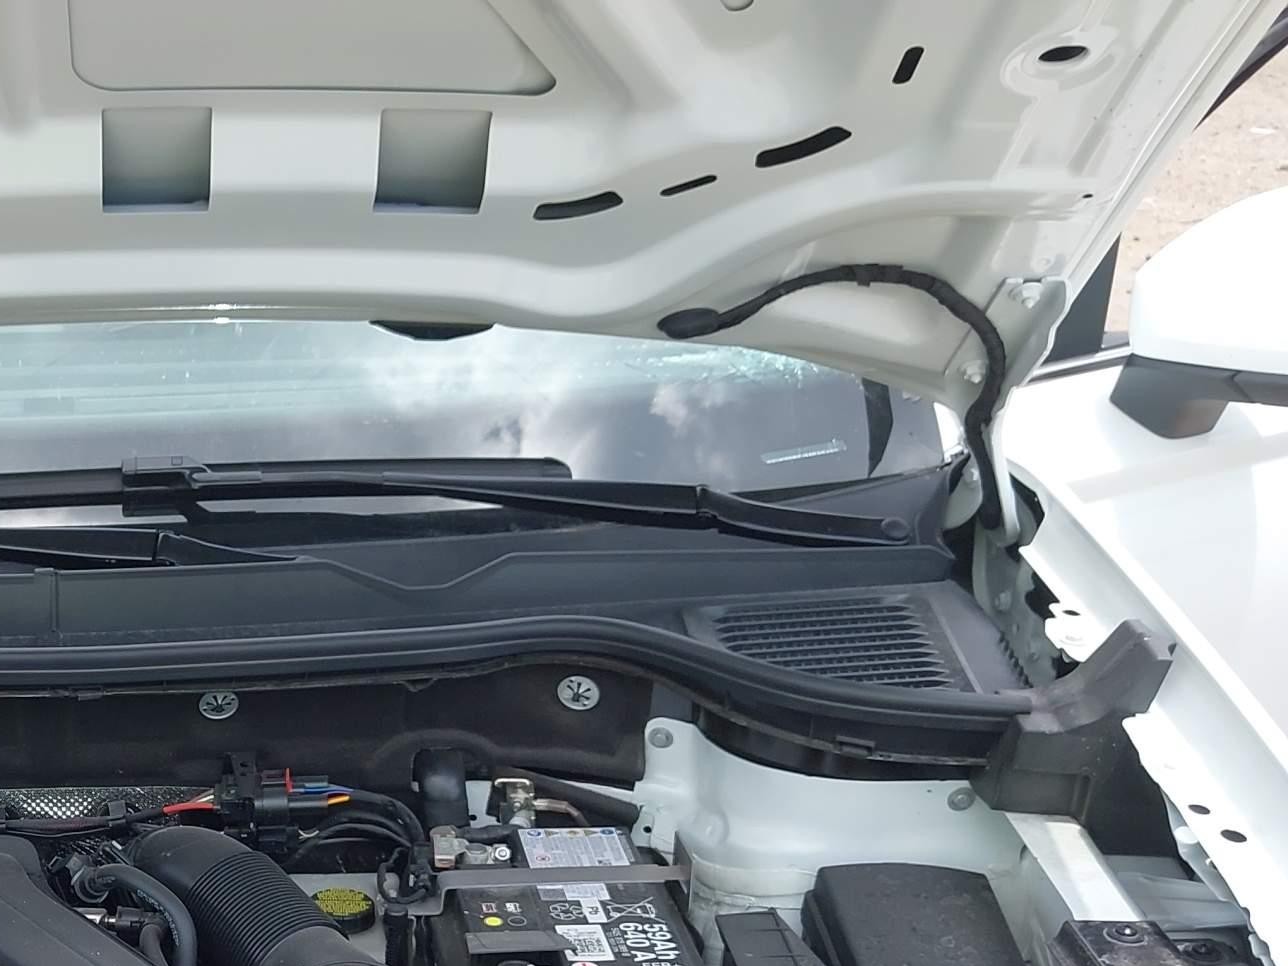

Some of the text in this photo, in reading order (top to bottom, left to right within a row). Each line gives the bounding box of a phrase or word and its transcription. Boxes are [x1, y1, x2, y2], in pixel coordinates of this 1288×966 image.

[619, 922, 650, 948] 640
[643, 923, 681, 960] 59Ah
[630, 950, 657, 962] A
